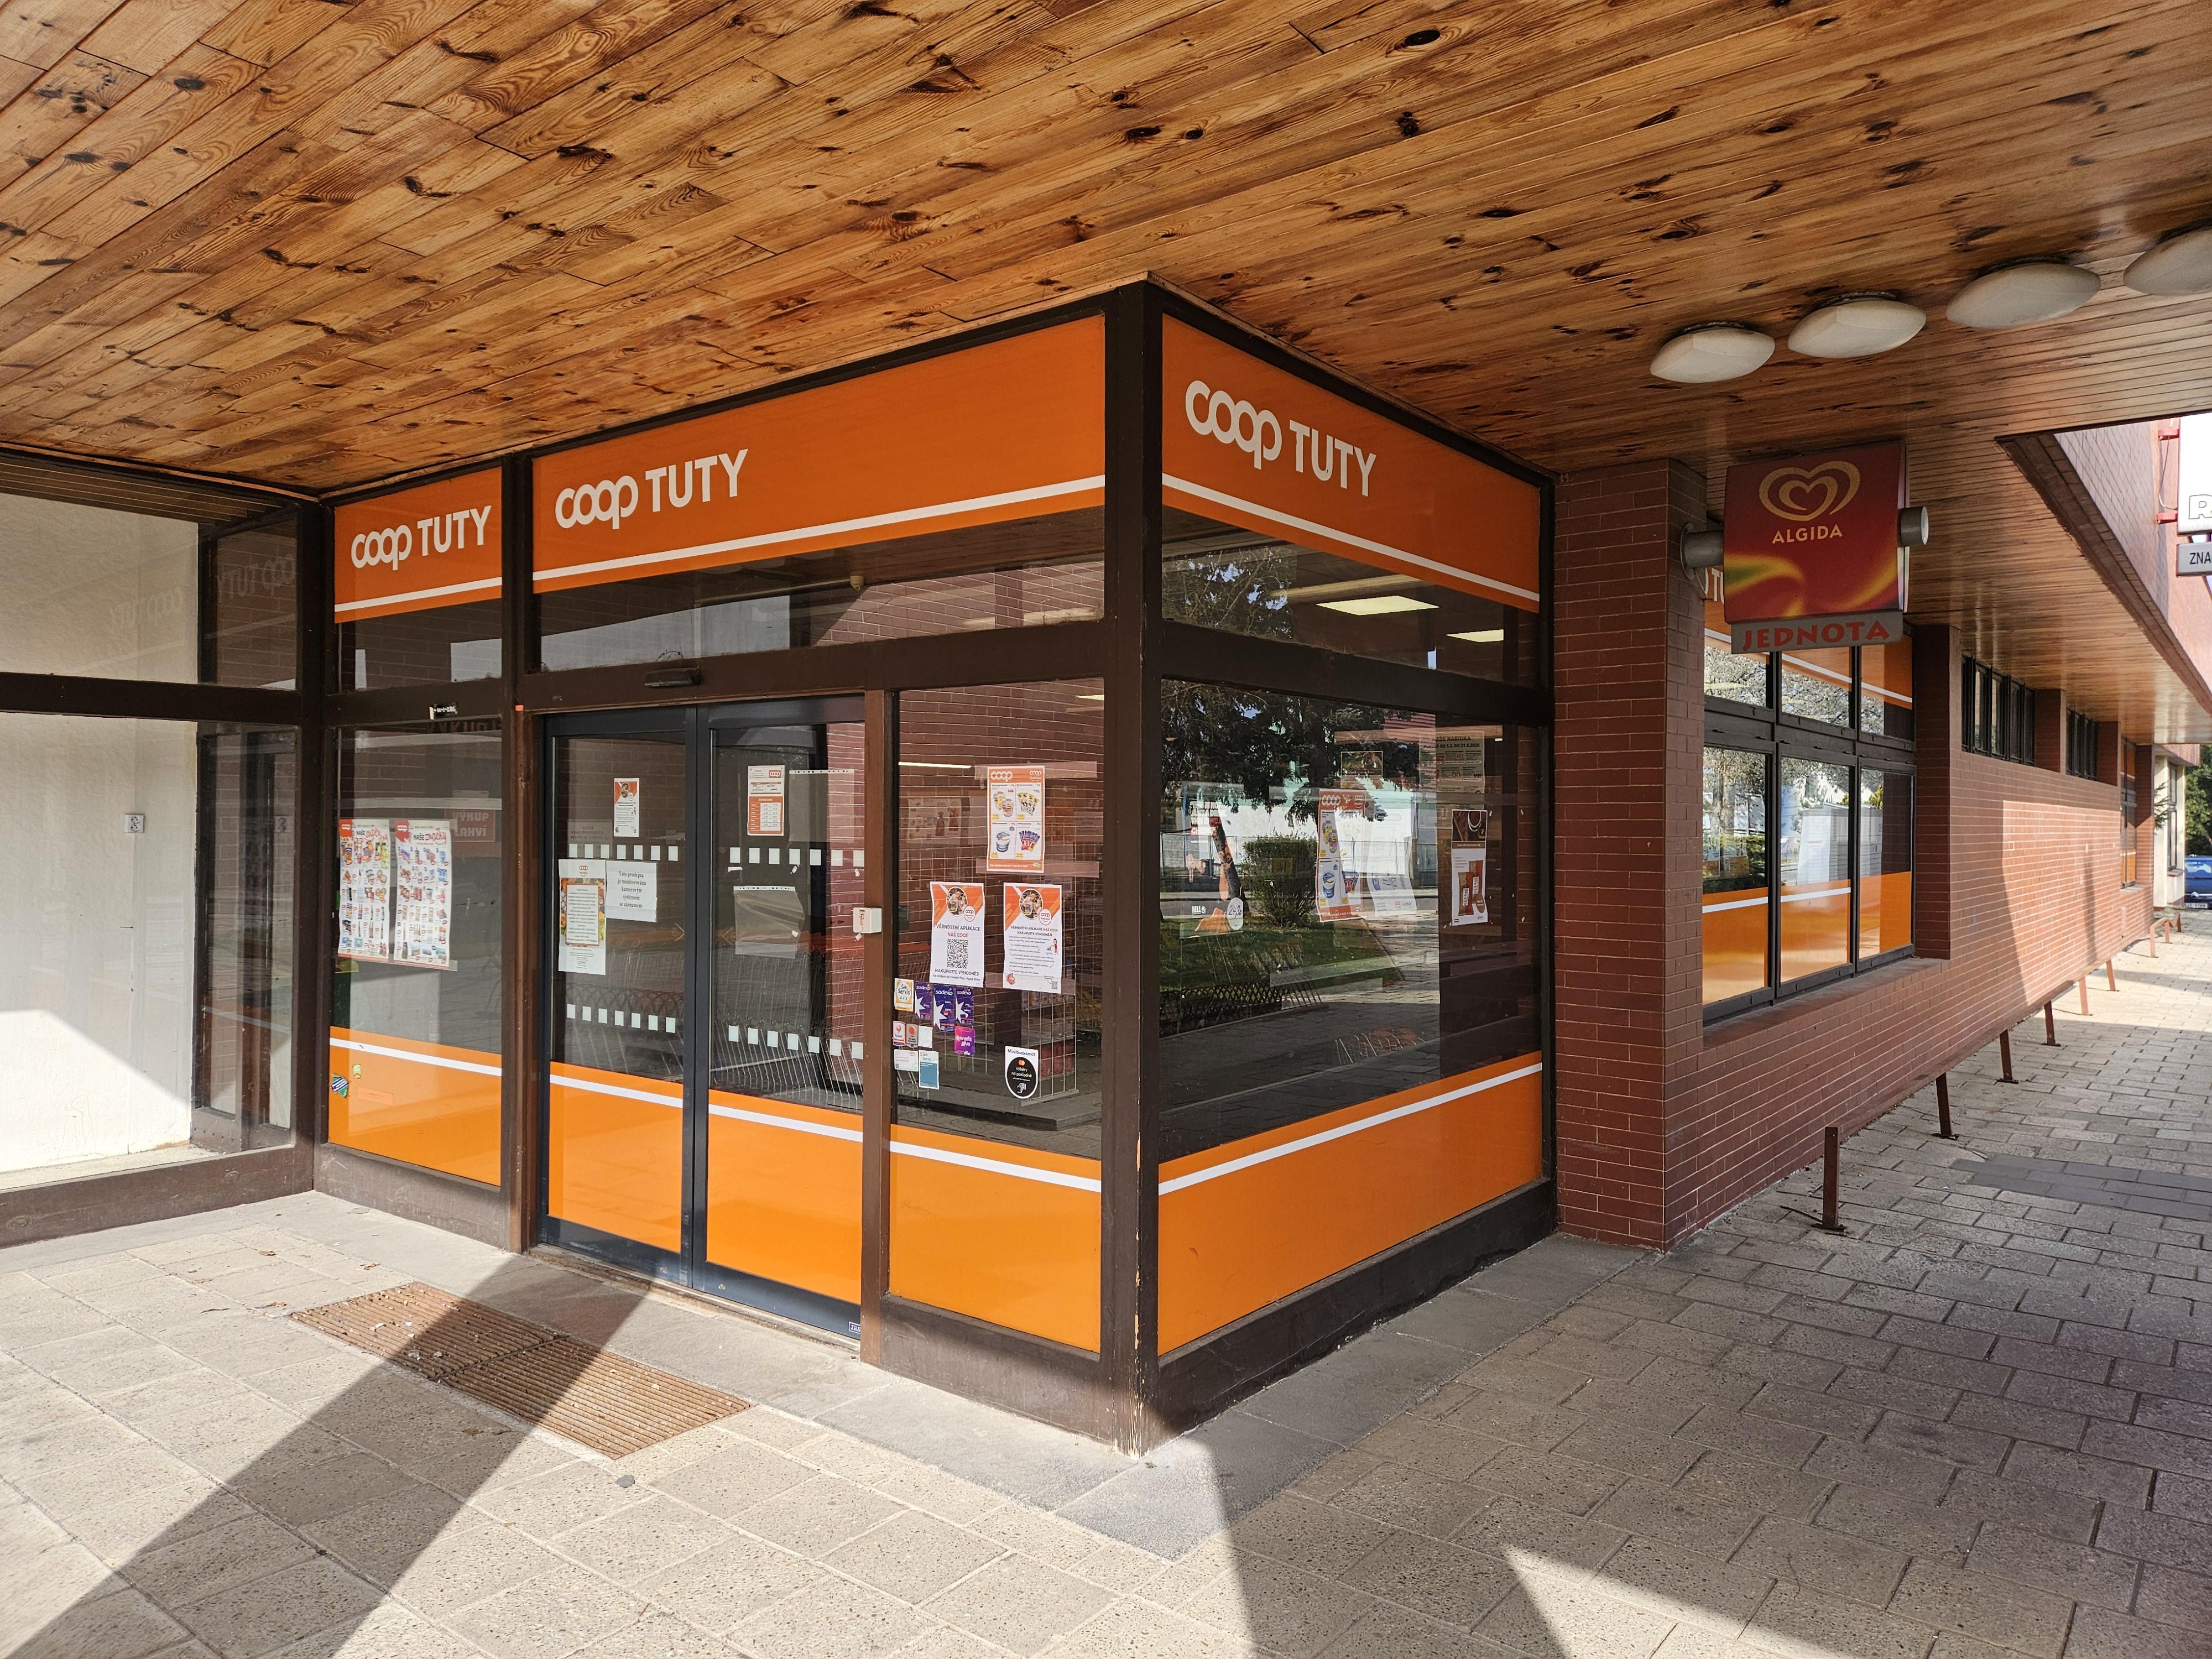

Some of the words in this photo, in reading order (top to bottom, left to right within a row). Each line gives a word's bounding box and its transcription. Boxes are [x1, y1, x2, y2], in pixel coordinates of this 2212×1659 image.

[1185, 380, 1282, 469] coop
[1289, 419, 1377, 497] TUTY
[555, 475, 639, 530] coop
[645, 448, 748, 512] TUTY
[351, 524, 412, 571] coop
[417, 505, 491, 556] TUTY
[1771, 523, 1843, 544] ALGIDA
[1742, 619, 1890, 651] JEDNOTA
[990, 771, 1013, 782] coop
[1322, 795, 1341, 808] coop
